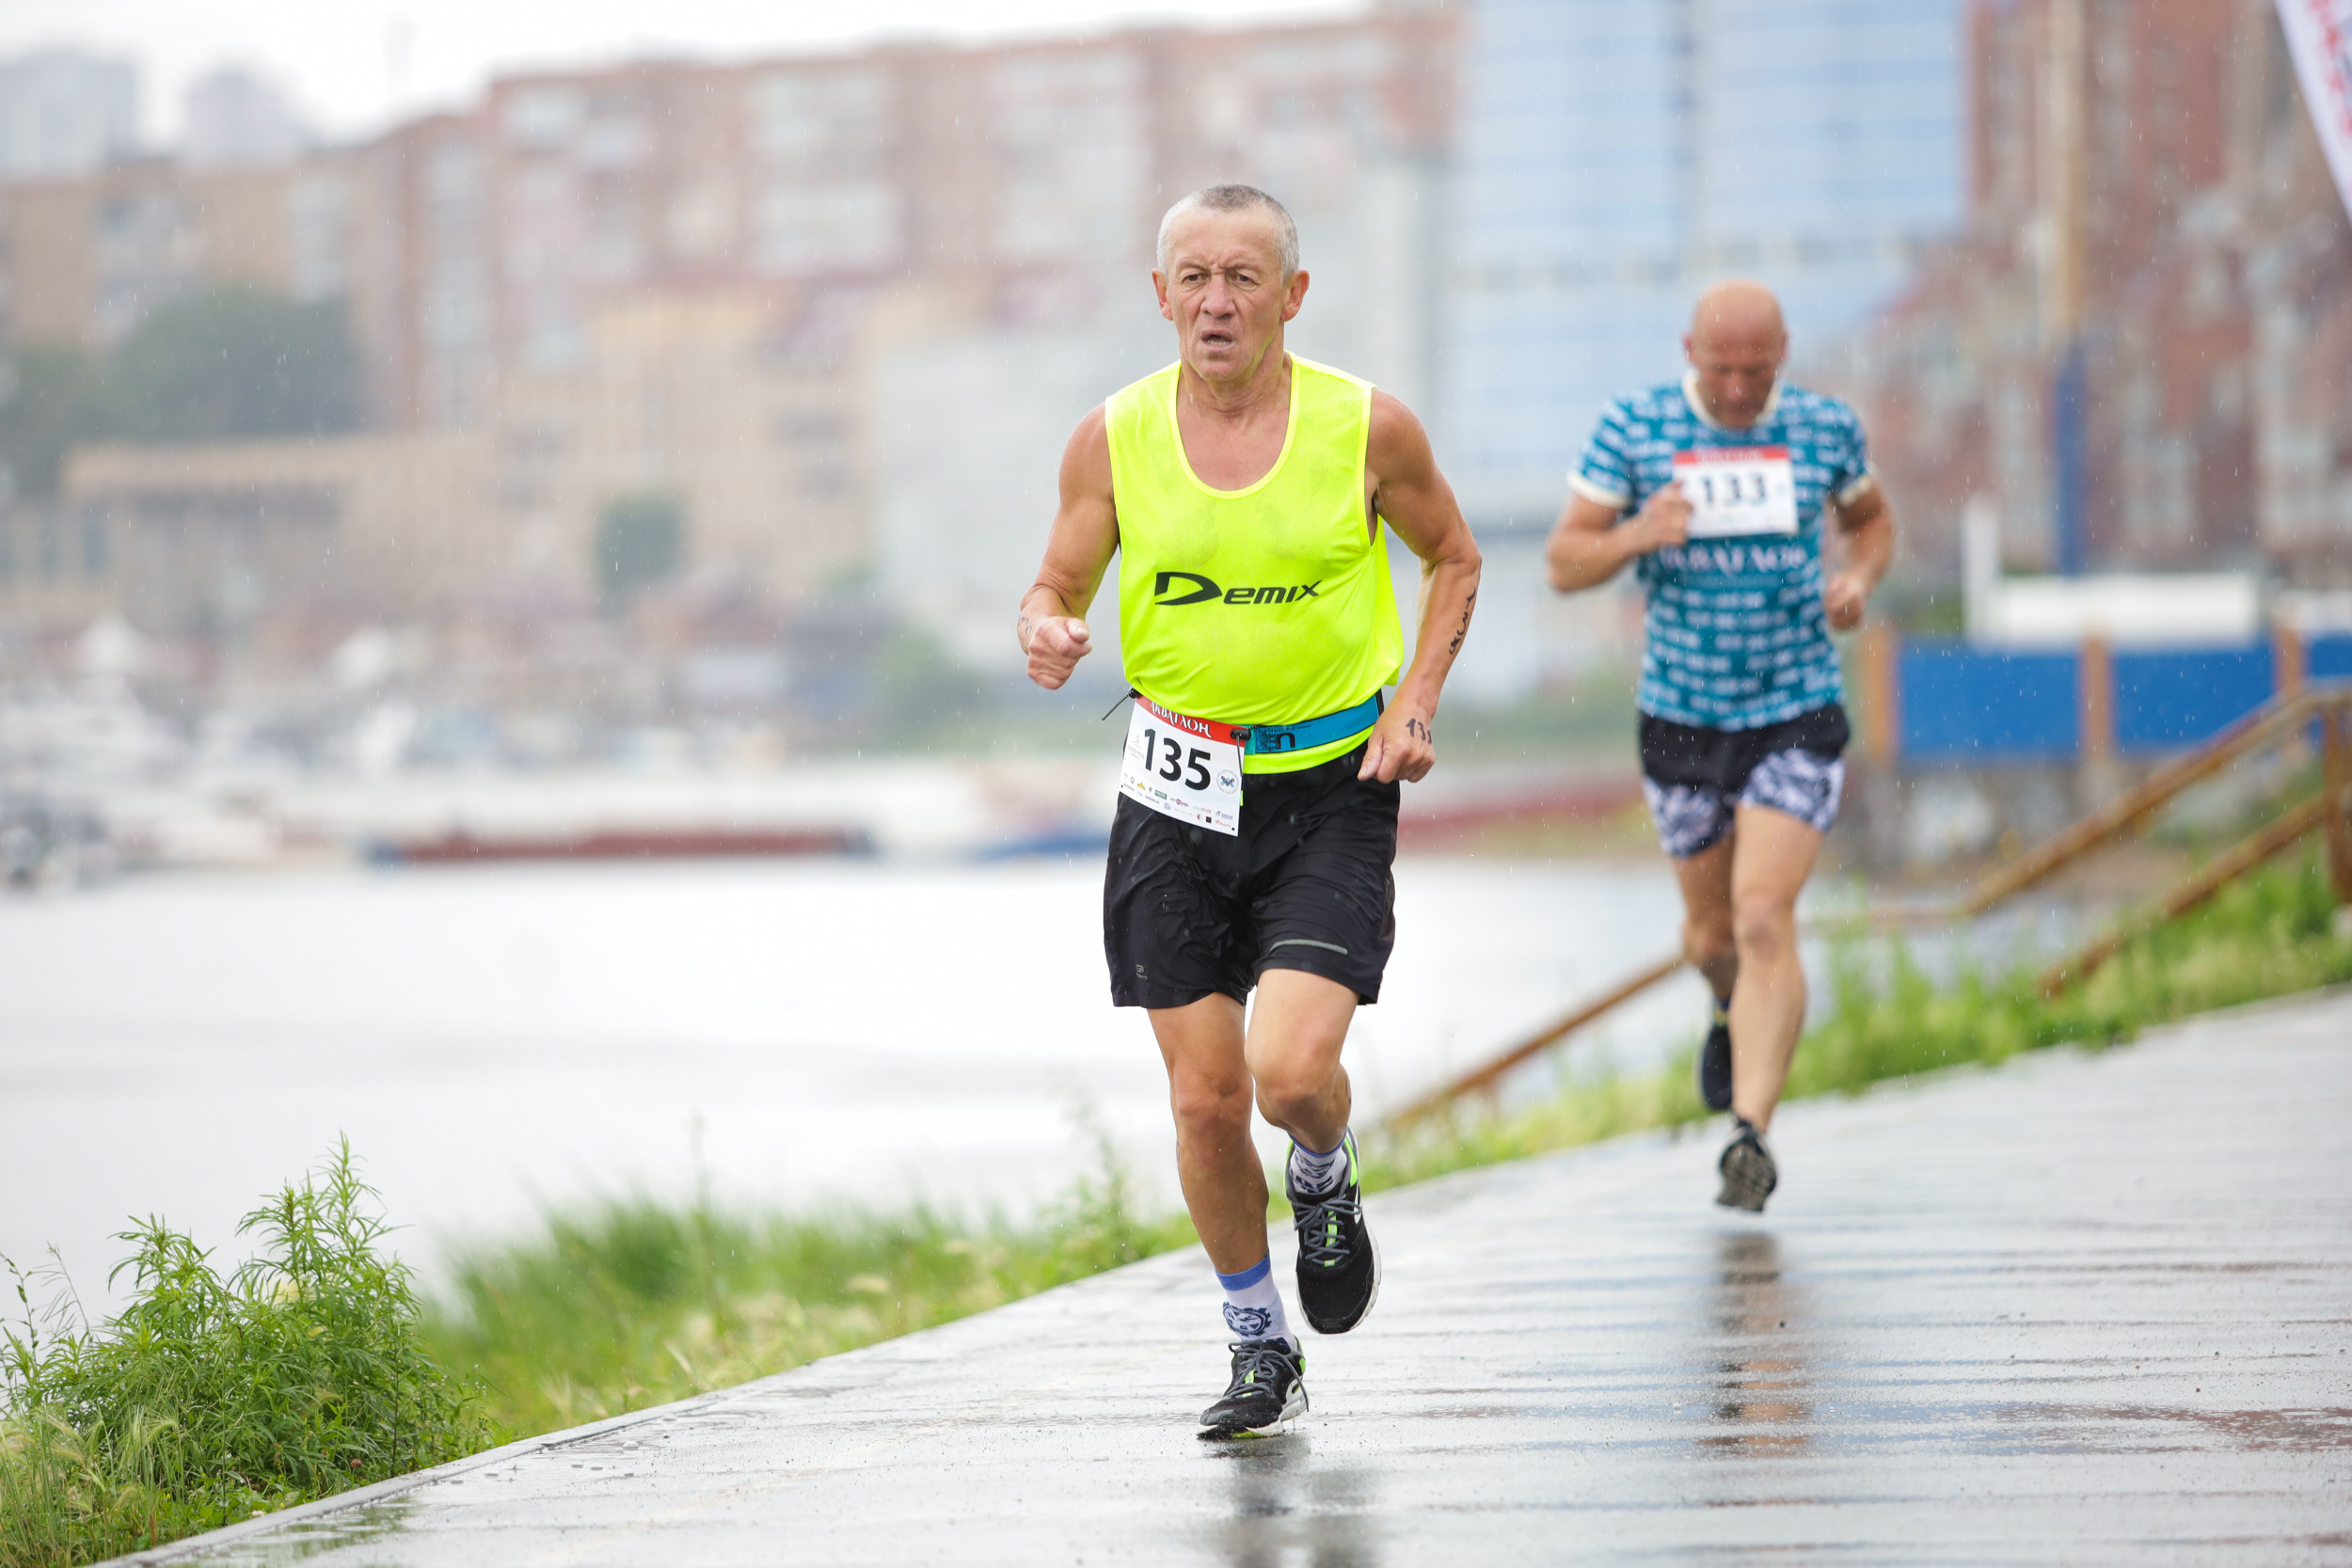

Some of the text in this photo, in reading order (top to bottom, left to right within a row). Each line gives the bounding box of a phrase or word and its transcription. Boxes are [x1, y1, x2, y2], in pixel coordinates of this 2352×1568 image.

[1700, 473, 1767, 507] 133
[1154, 571, 1322, 606] Demix
[1144, 728, 1211, 791] 135
